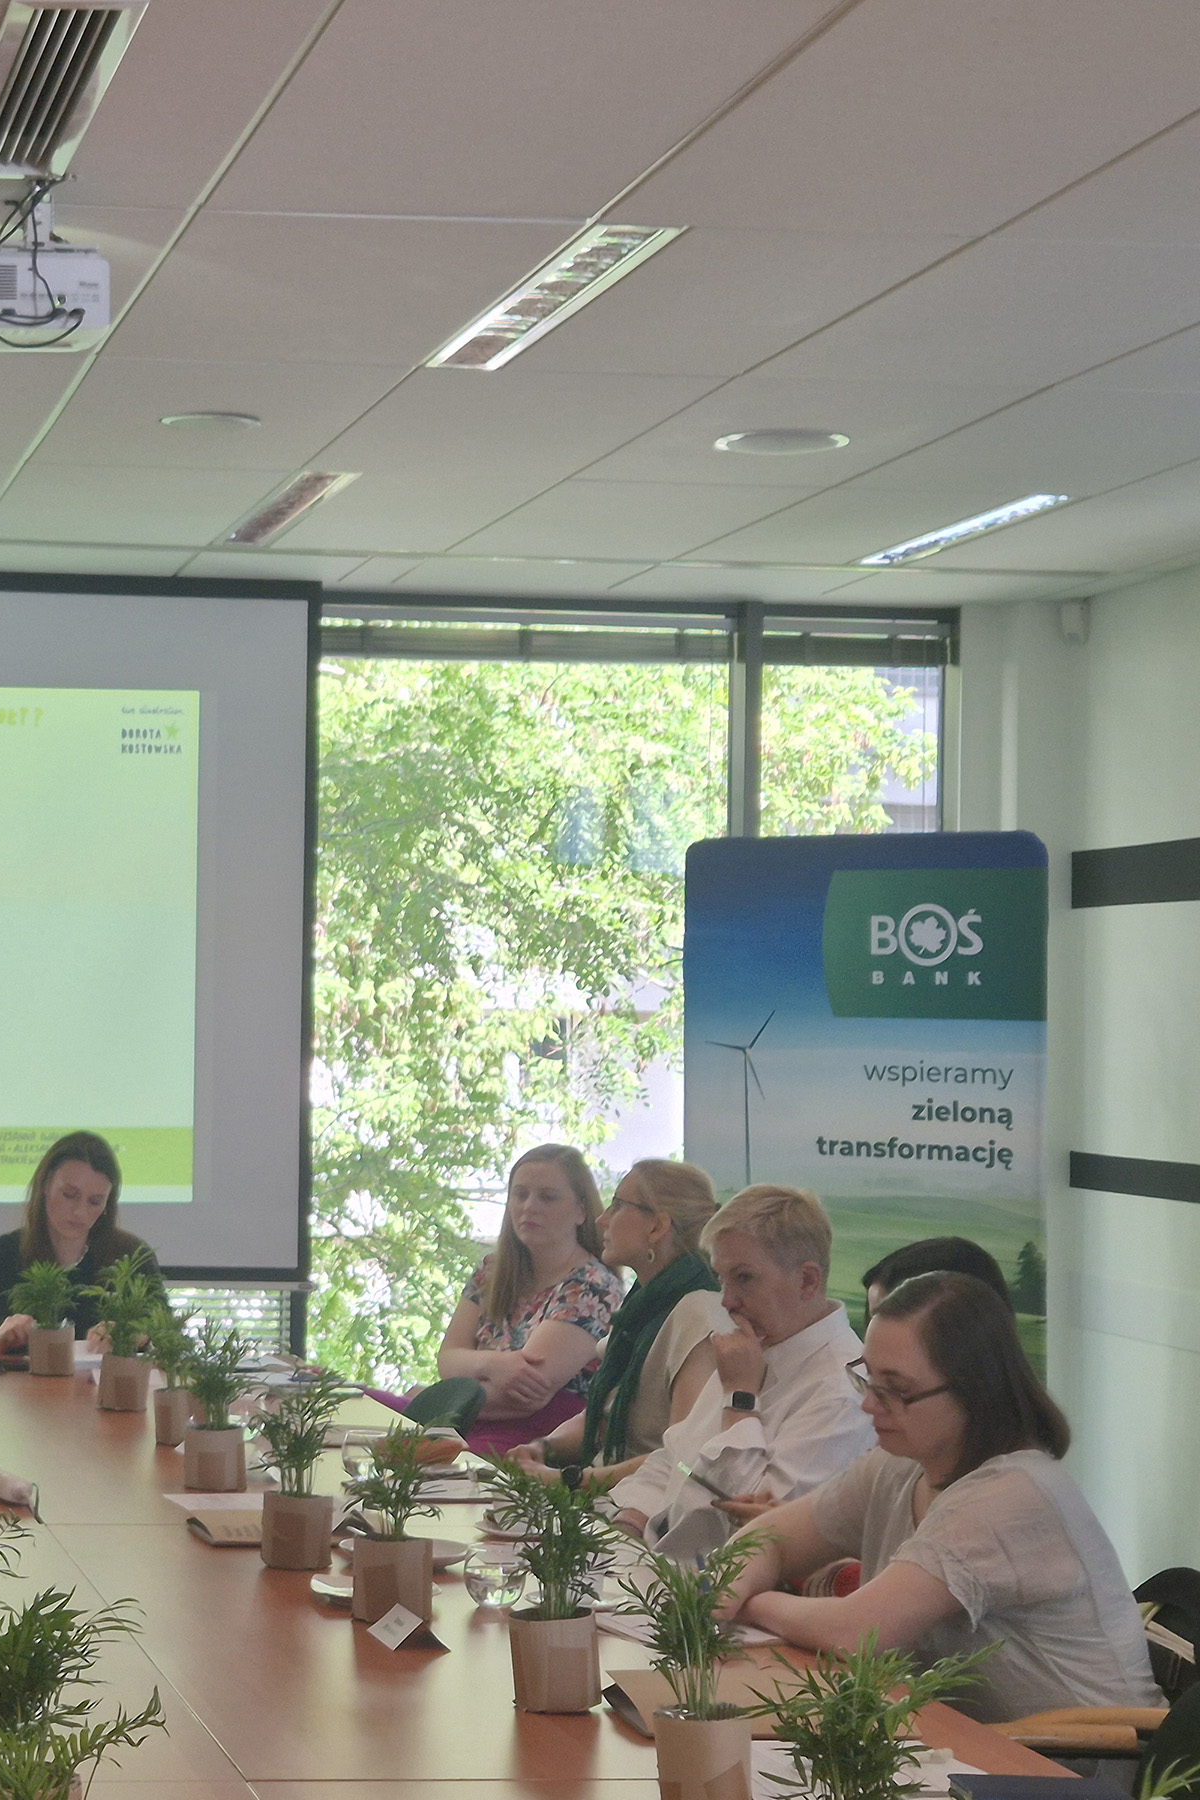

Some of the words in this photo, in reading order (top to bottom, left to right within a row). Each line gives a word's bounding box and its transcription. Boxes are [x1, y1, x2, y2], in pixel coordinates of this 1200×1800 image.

[121, 728, 162, 740] DOROTA
[121, 743, 183, 755] KOSTOWSKA
[870, 903, 984, 967] BOŚ
[871, 970, 982, 986] BANK
[863, 1060, 1015, 1091] wspieramy
[911, 1098, 1014, 1131] zieloną
[815, 1135, 1014, 1171] transformację
